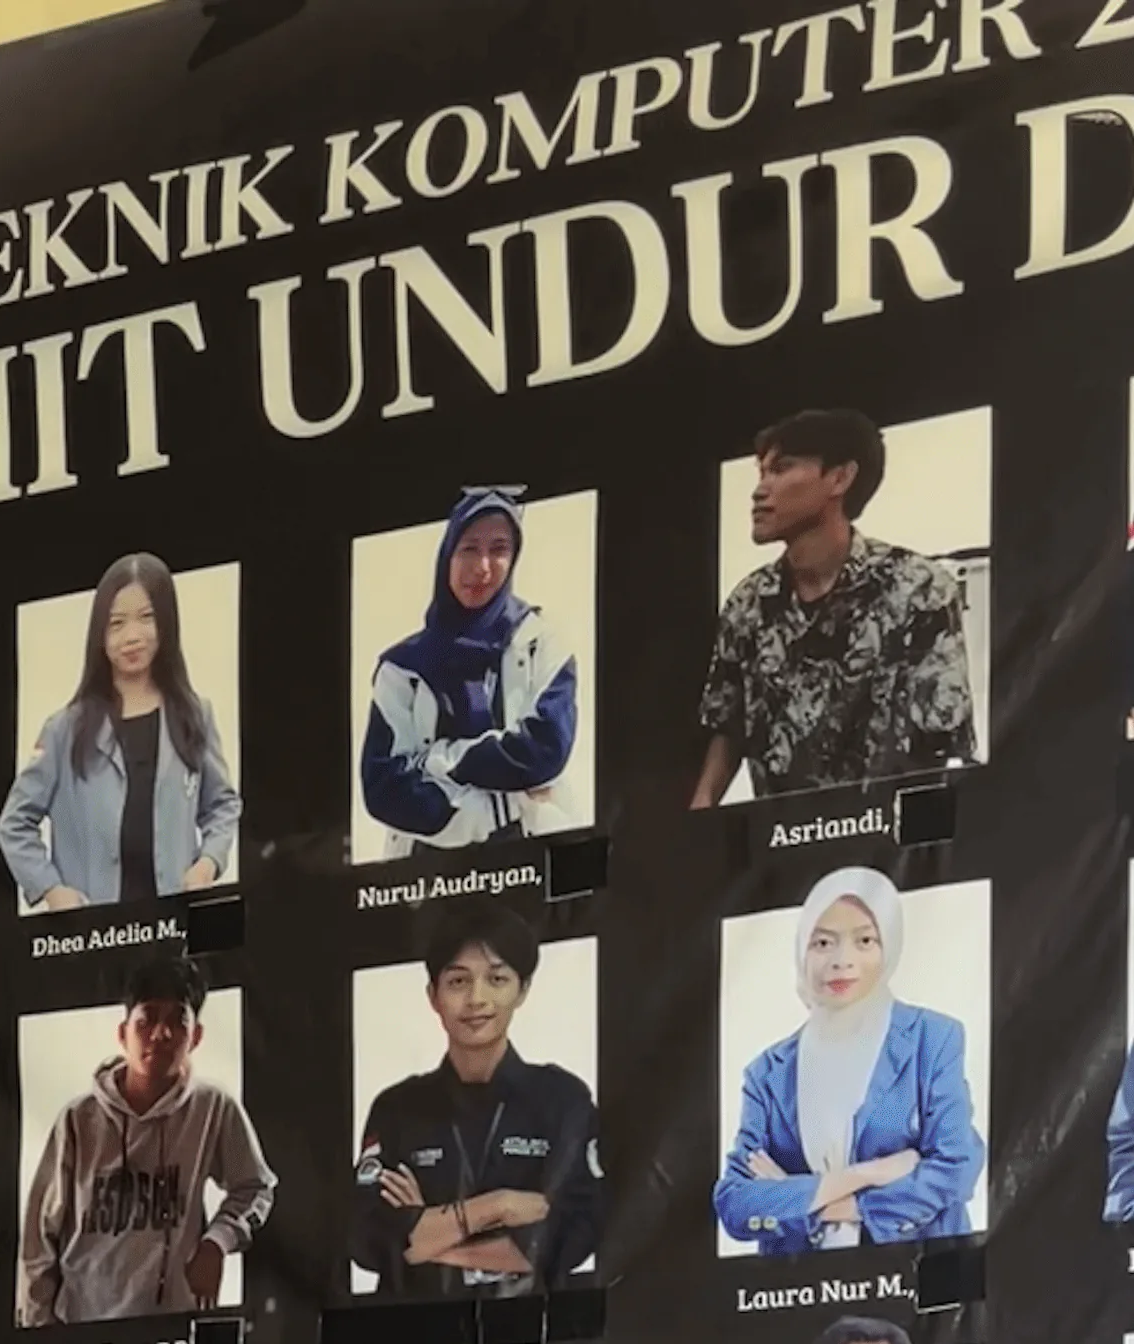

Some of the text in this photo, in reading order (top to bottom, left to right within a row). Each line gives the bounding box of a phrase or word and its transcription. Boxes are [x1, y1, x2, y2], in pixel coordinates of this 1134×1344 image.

[319, 0, 1043, 223] KOMPUTER
[247, 135, 964, 440] UNDUR
[769, 807, 890, 848] Asriandi,
[356, 864, 543, 909] Nurul Audryan,
[31, 935, 84, 957] Dhea
[87, 922, 154, 950] Adelia
[736, 1287, 815, 1311] Laura
[820, 1280, 872, 1303] Nur
